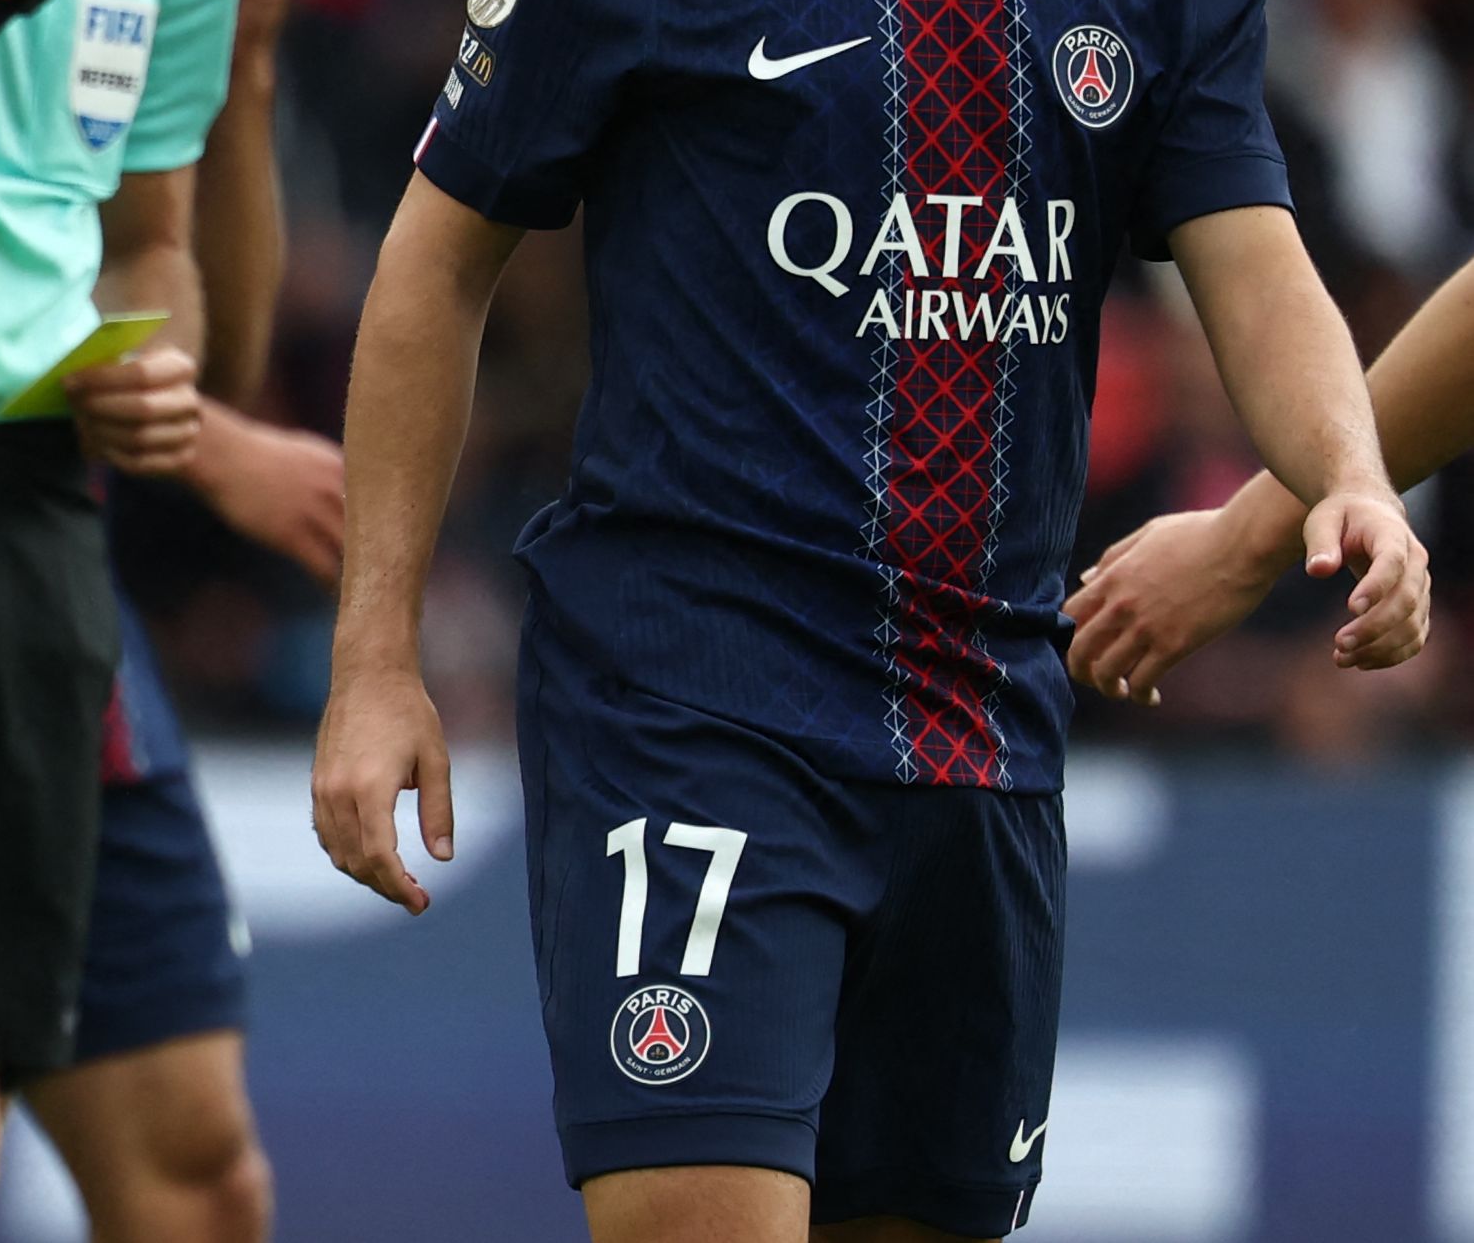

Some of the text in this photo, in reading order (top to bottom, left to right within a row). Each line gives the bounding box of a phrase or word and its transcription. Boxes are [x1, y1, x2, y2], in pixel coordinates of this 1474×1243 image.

[1063, 30, 1121, 58] PARIS
[766, 191, 1076, 298] QATAR
[855, 286, 1070, 346] AIRWAYS
[606, 816, 749, 978] 17
[626, 989, 694, 1015] PARIS
